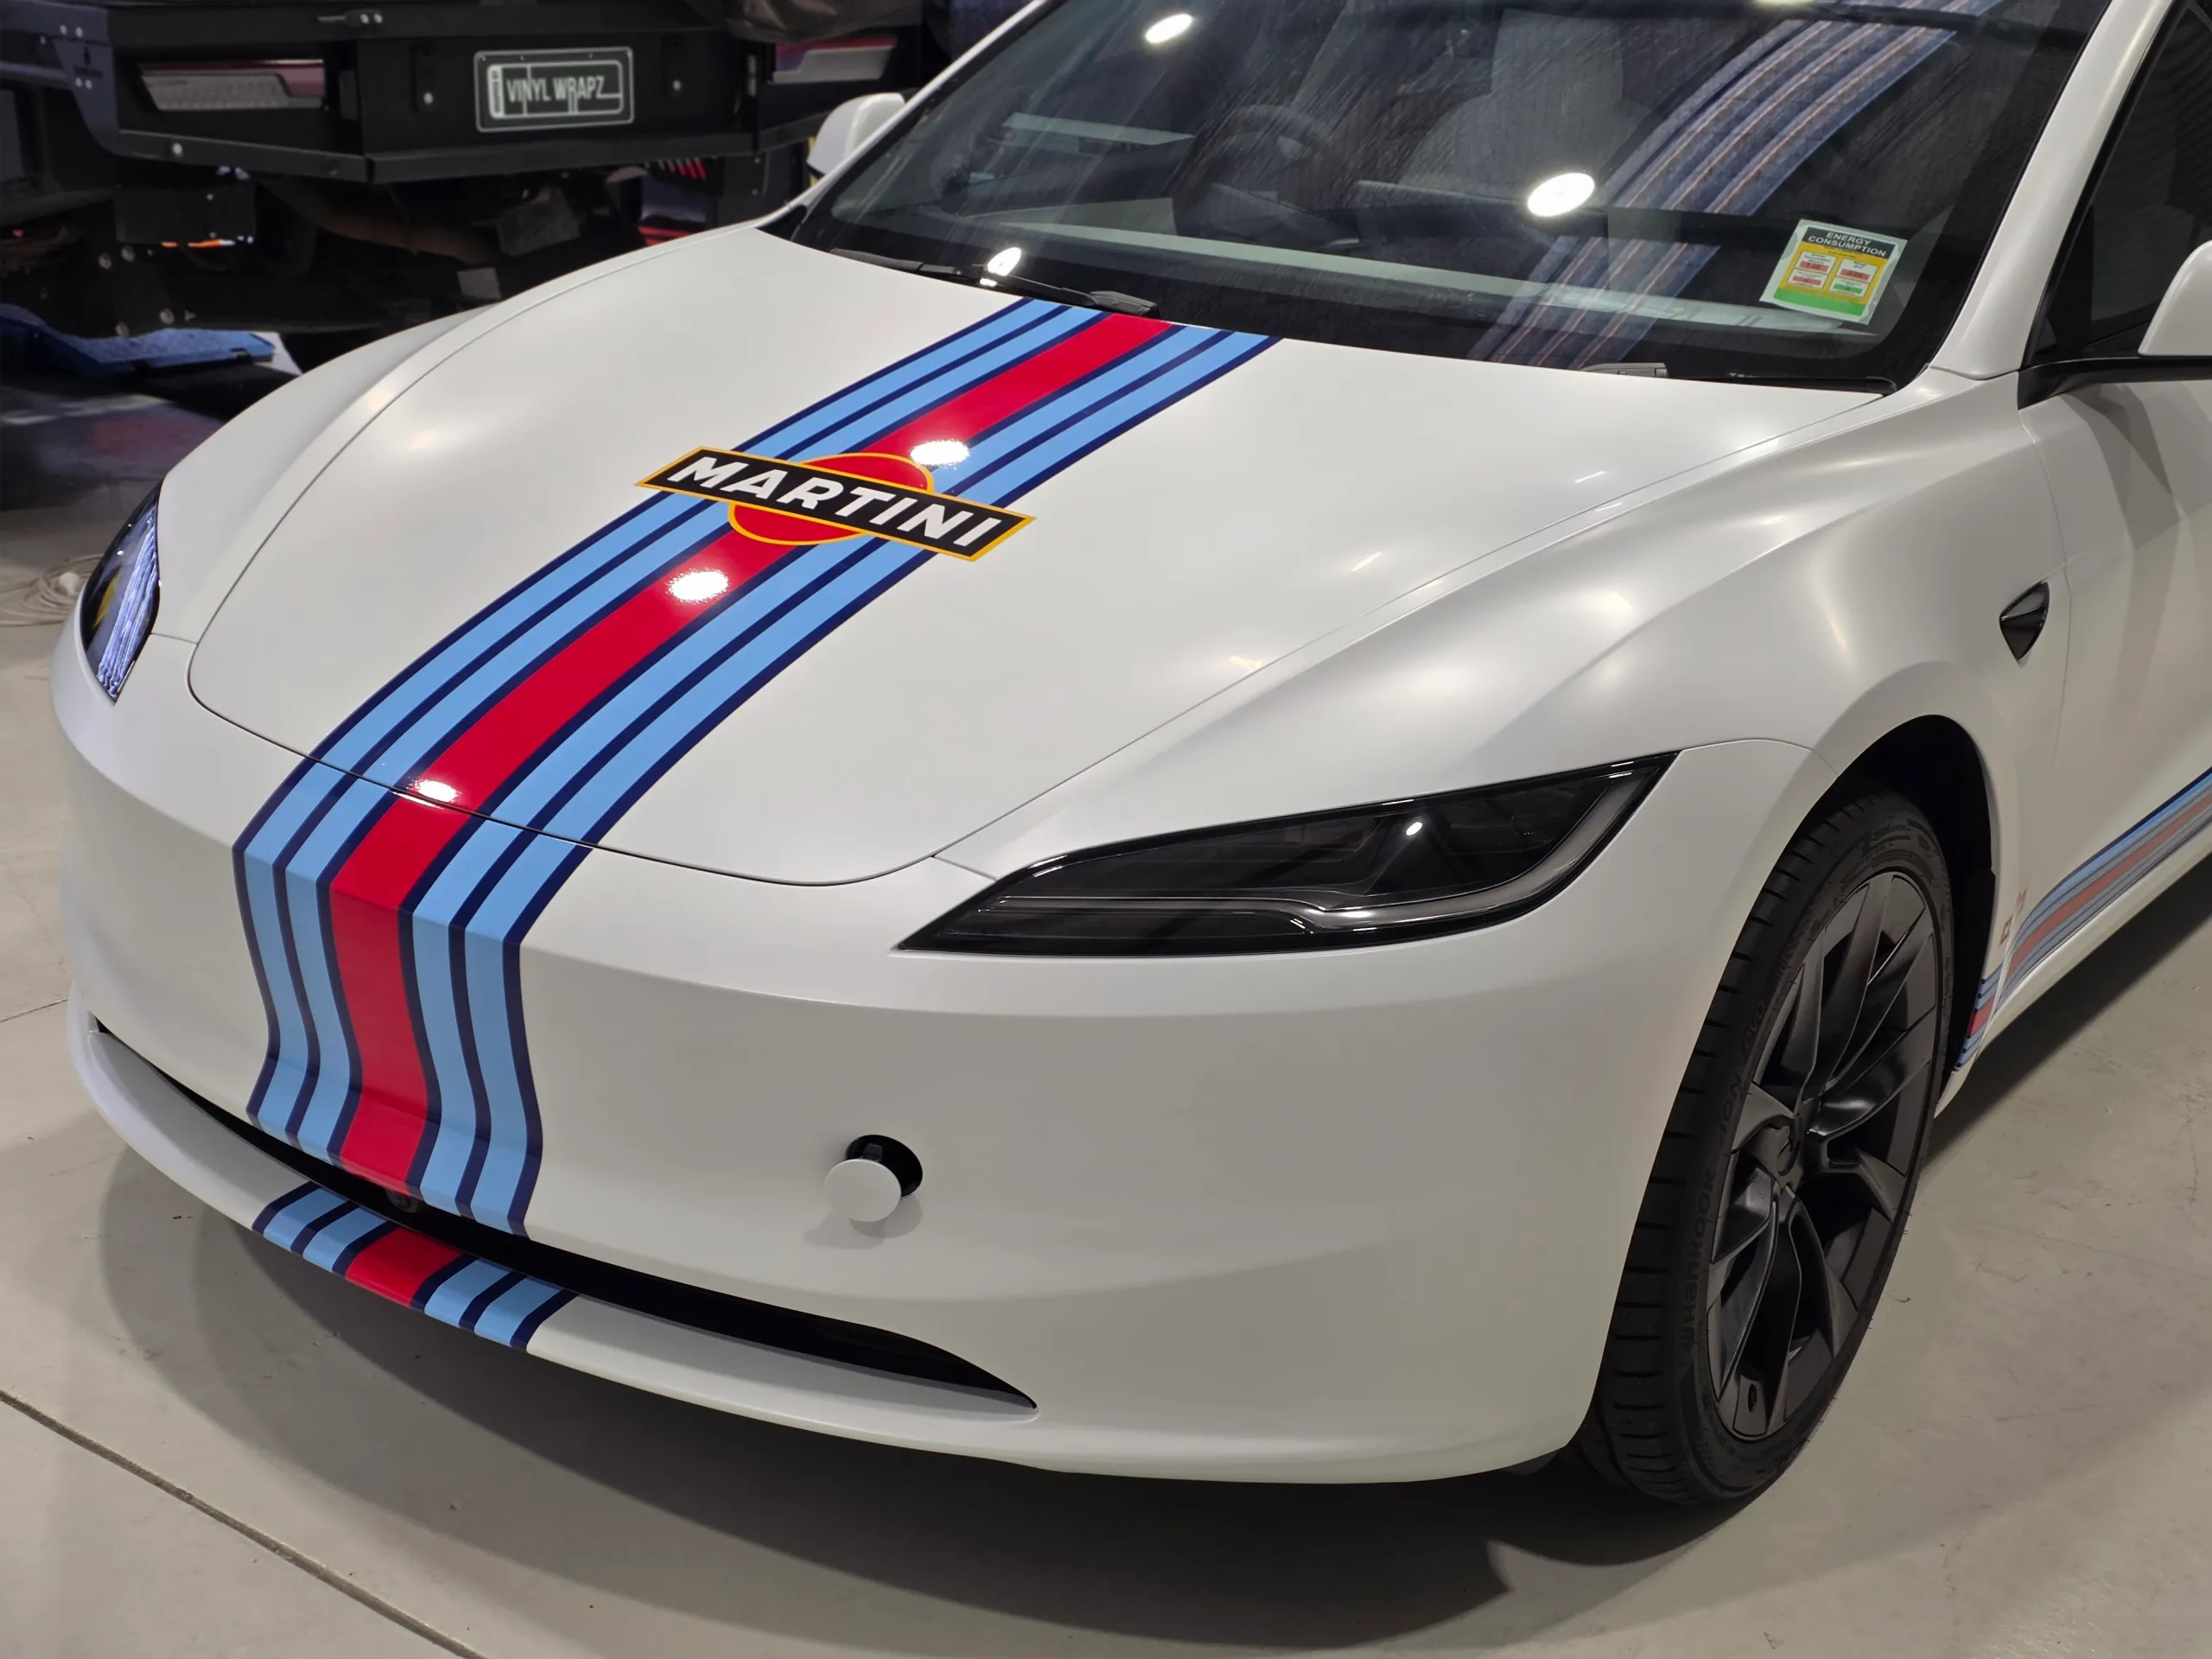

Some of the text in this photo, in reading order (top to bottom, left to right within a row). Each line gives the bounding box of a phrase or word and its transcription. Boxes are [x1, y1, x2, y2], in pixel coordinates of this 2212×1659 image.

[506, 77, 552, 103] VINYL
[553, 75, 605, 101] WRAPZ
[1808, 235, 1887, 257] CONSUMPTION
[1826, 231, 1872, 246] ENERGY
[667, 456, 1002, 548] MARTINI
